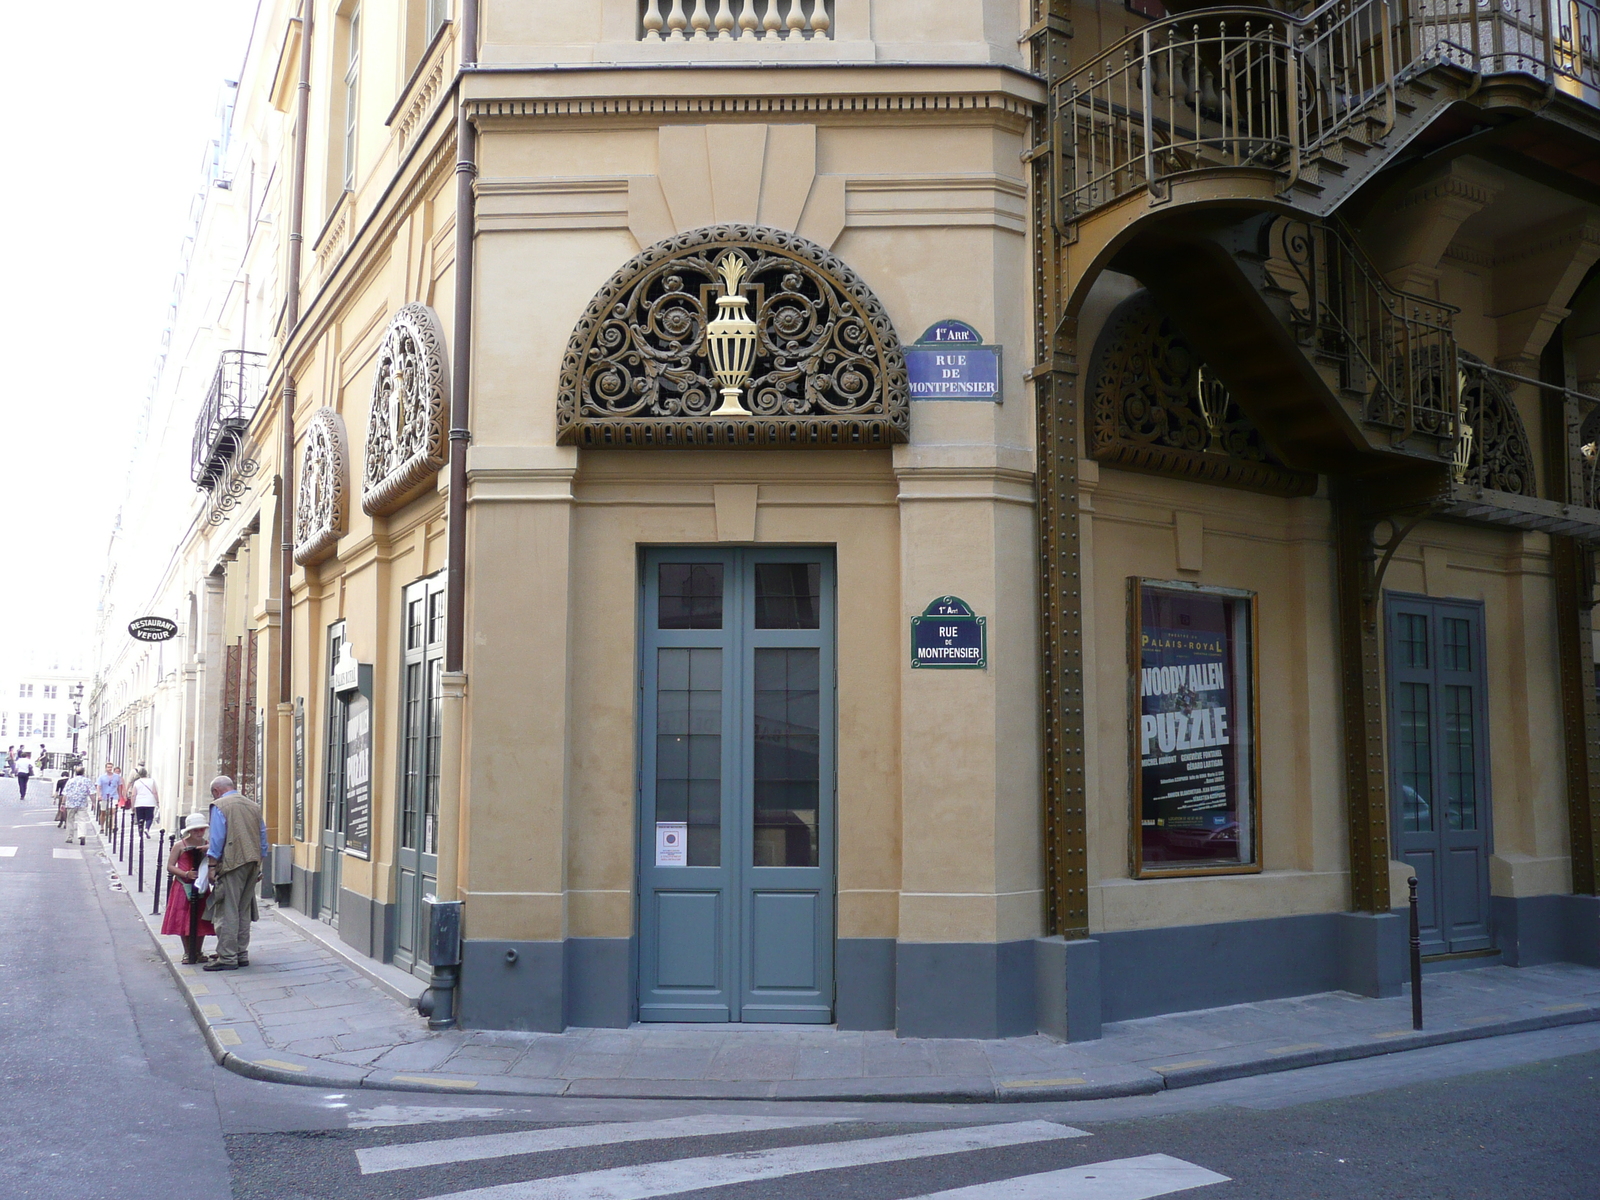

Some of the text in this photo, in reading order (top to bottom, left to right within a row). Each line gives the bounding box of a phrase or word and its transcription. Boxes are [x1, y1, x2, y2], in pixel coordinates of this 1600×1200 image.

[936, 355, 966, 366] RUE
[942, 369, 960, 379] DE
[908, 382, 995, 393] MONTPENSIER
[130, 619, 175, 631] RESTAURANT
[137, 630, 170, 640] VEFOUR
[939, 626, 958, 637] RUE
[1142, 634, 1222, 653] PALAIS-ROYAL
[918, 647, 980, 658] MONTPENSIER
[1188, 662, 1225, 692] ALLEN
[1141, 707, 1230, 755] PUZZLE
